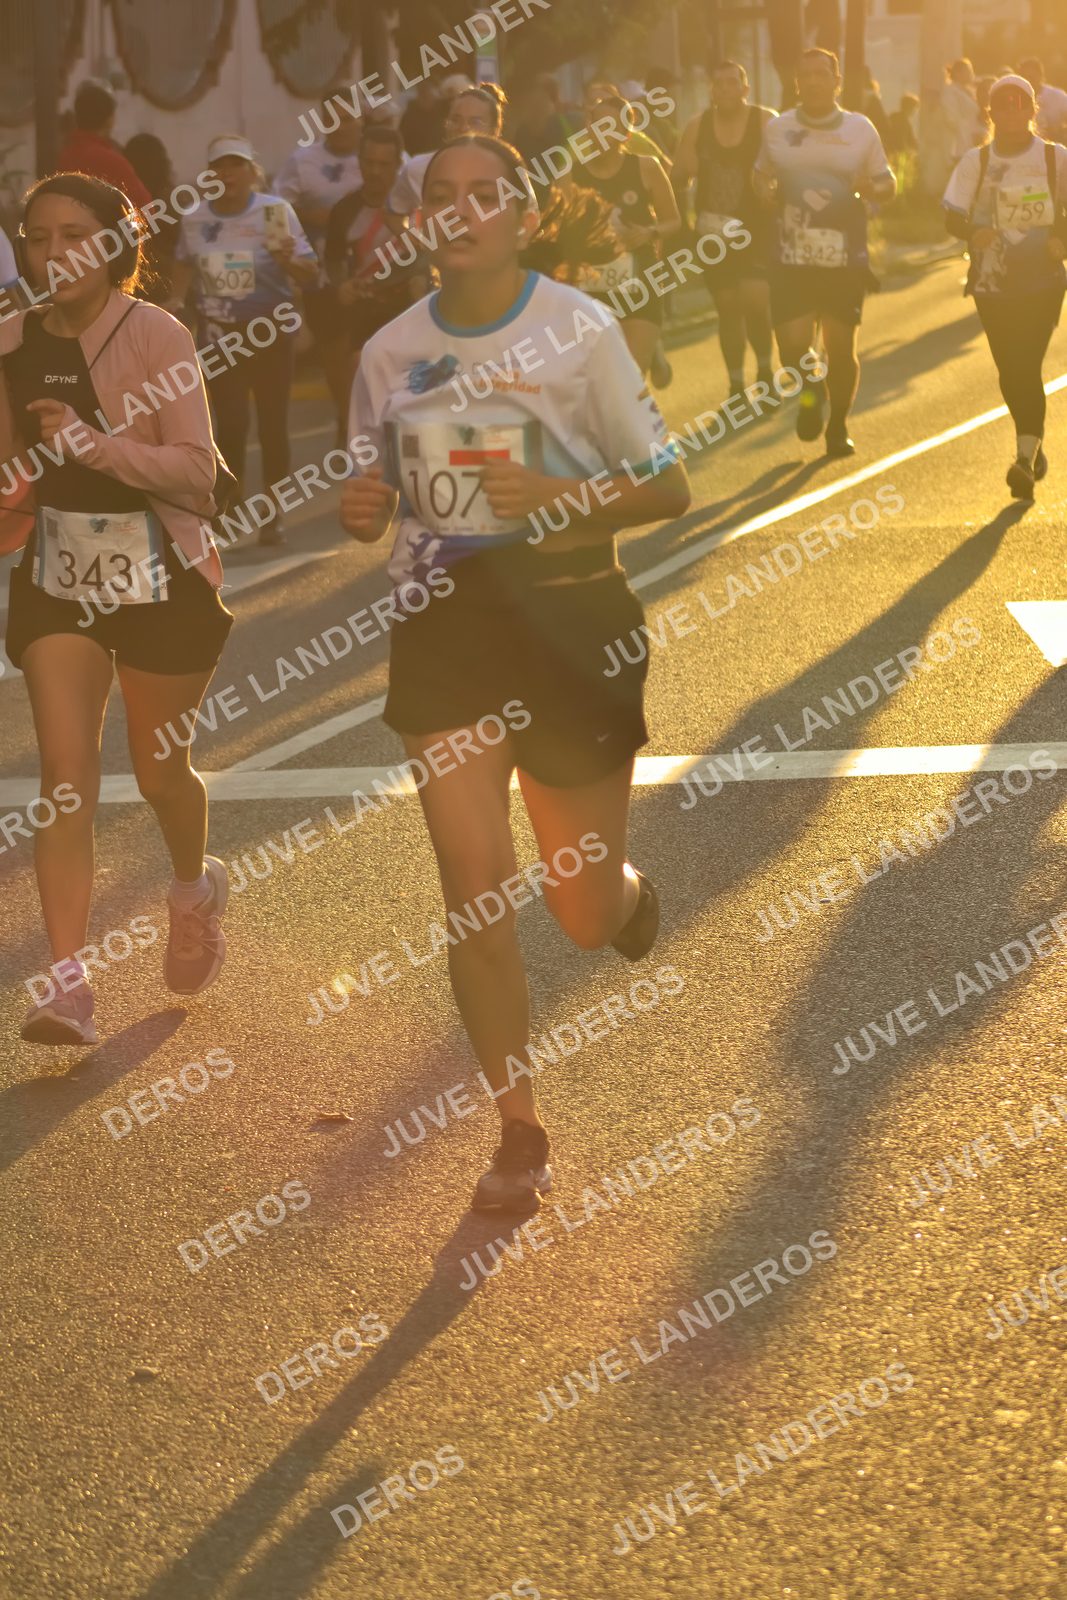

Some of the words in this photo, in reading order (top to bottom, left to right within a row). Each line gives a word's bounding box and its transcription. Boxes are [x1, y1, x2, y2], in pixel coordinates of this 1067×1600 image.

[1006, 201, 1045, 222] 759
[45, 375, 78, 383] DFYNE
[57, 550, 133, 593] 343
